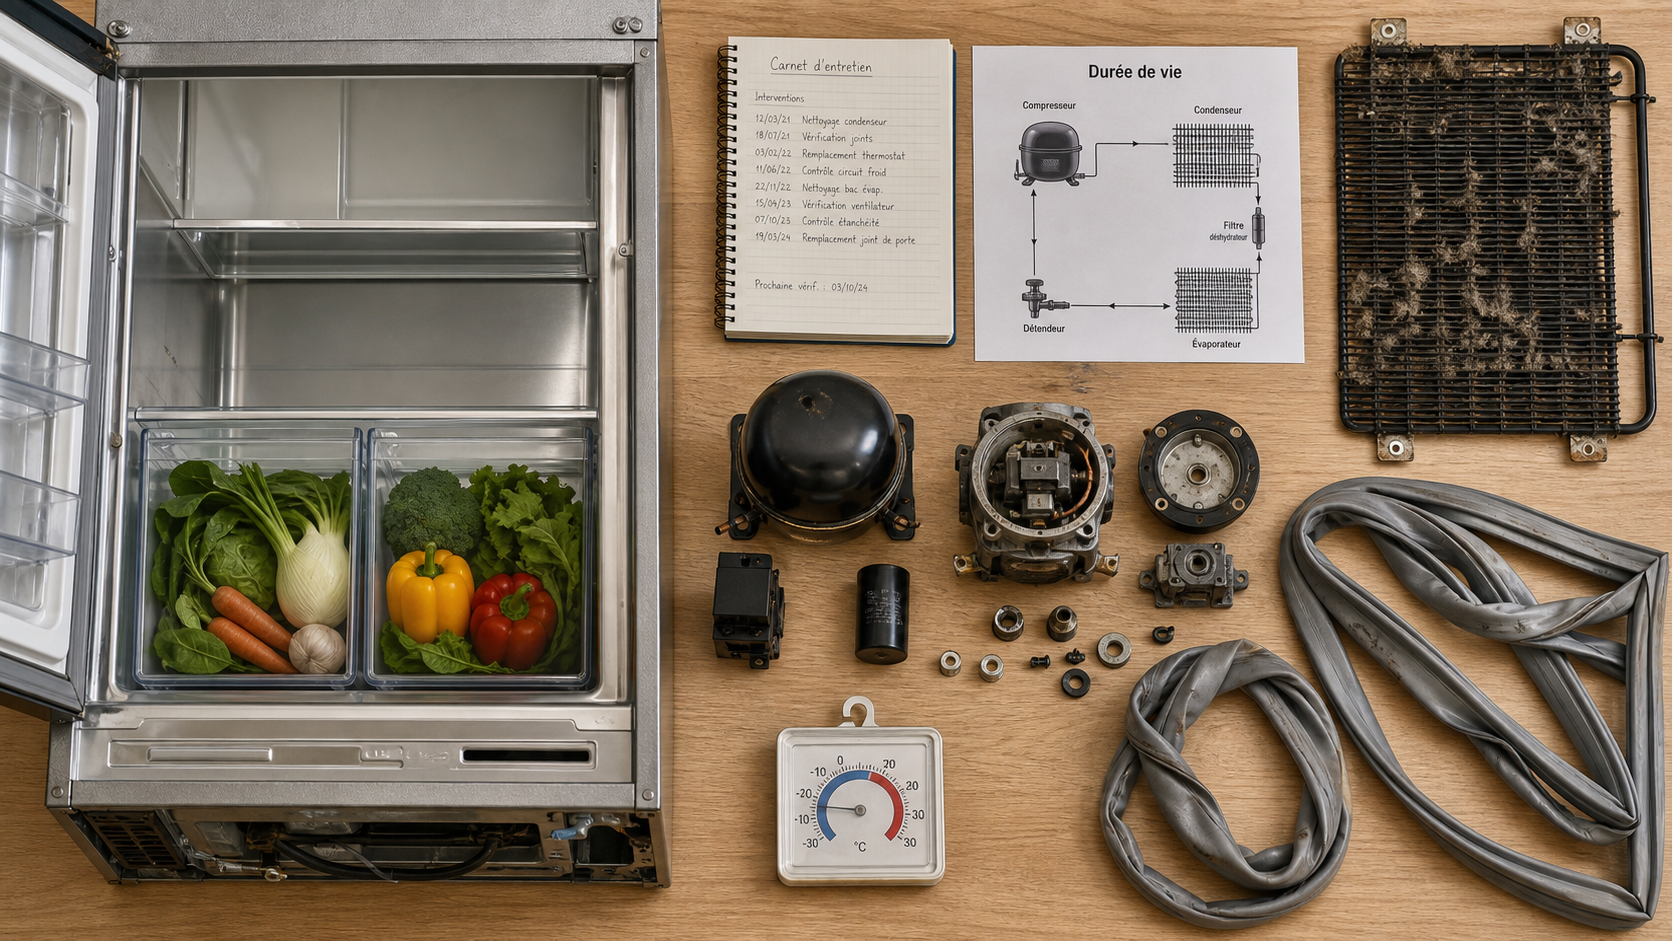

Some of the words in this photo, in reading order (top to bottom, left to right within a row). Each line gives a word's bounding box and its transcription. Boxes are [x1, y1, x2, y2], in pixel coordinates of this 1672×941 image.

[770, 56, 808, 71] Carnet
[814, 59, 872, 72] d'entretien
[1088, 64, 1133, 79] Durée
[1137, 64, 1156, 79] de
[1160, 64, 1182, 79] vie
[755, 91, 805, 103] Interventions
[1022, 101, 1076, 110] Compresseur
[1194, 105, 1243, 115] Condenseur
[755, 113, 791, 124] 12/03/21
[802, 115, 840, 129] Nettoyage
[844, 116, 887, 126] condenseur
[755, 130, 790, 140] 18/07/21
[802, 131, 846, 142] Vérification
[849, 133, 873, 147] joints
[755, 147, 792, 159] 03/02/22
[802, 148, 857, 162] Remplacement
[862, 150, 906, 160] thermostat
[755, 164, 791, 175] 11/06/22
[802, 165, 834, 176] Contrôle
[838, 167, 863, 176] circuit
[868, 167, 887, 177] froid
[755, 181, 791, 192] 22/11/22
[802, 183, 840, 197] Nettoyage
[844, 184, 858, 194] bac
[862, 184, 883, 196] évap.
[755, 198, 792, 209] 15/04/23
[802, 199, 847, 210] Vérification
[851, 201, 895, 211] ventilateur
[754, 215, 791, 225] 07/10/23
[802, 216, 834, 227] Contrôle
[838, 217, 880, 227] étanchéité
[1223, 221, 1244, 230] Filtre
[802, 232, 857, 246] Remplacement
[859, 235, 878, 247] joint
[882, 235, 892, 245] de
[895, 236, 916, 248] porte
[755, 278, 793, 290] Prochaine
[798, 281, 819, 291] vérif.
[831, 282, 868, 294] 03/10/24
[1023, 324, 1065, 333] Détendeur
[1192, 338, 1241, 349] Évaporateur
[837, 755, 844, 765] 0
[810, 767, 827, 777] -10
[905, 780, 919, 791] 20
[795, 788, 812, 799] -20
[911, 809, 925, 820] 30
[802, 838, 819, 848] -30
[853, 841, 866, 852] °C
[903, 837, 917, 848] 30
